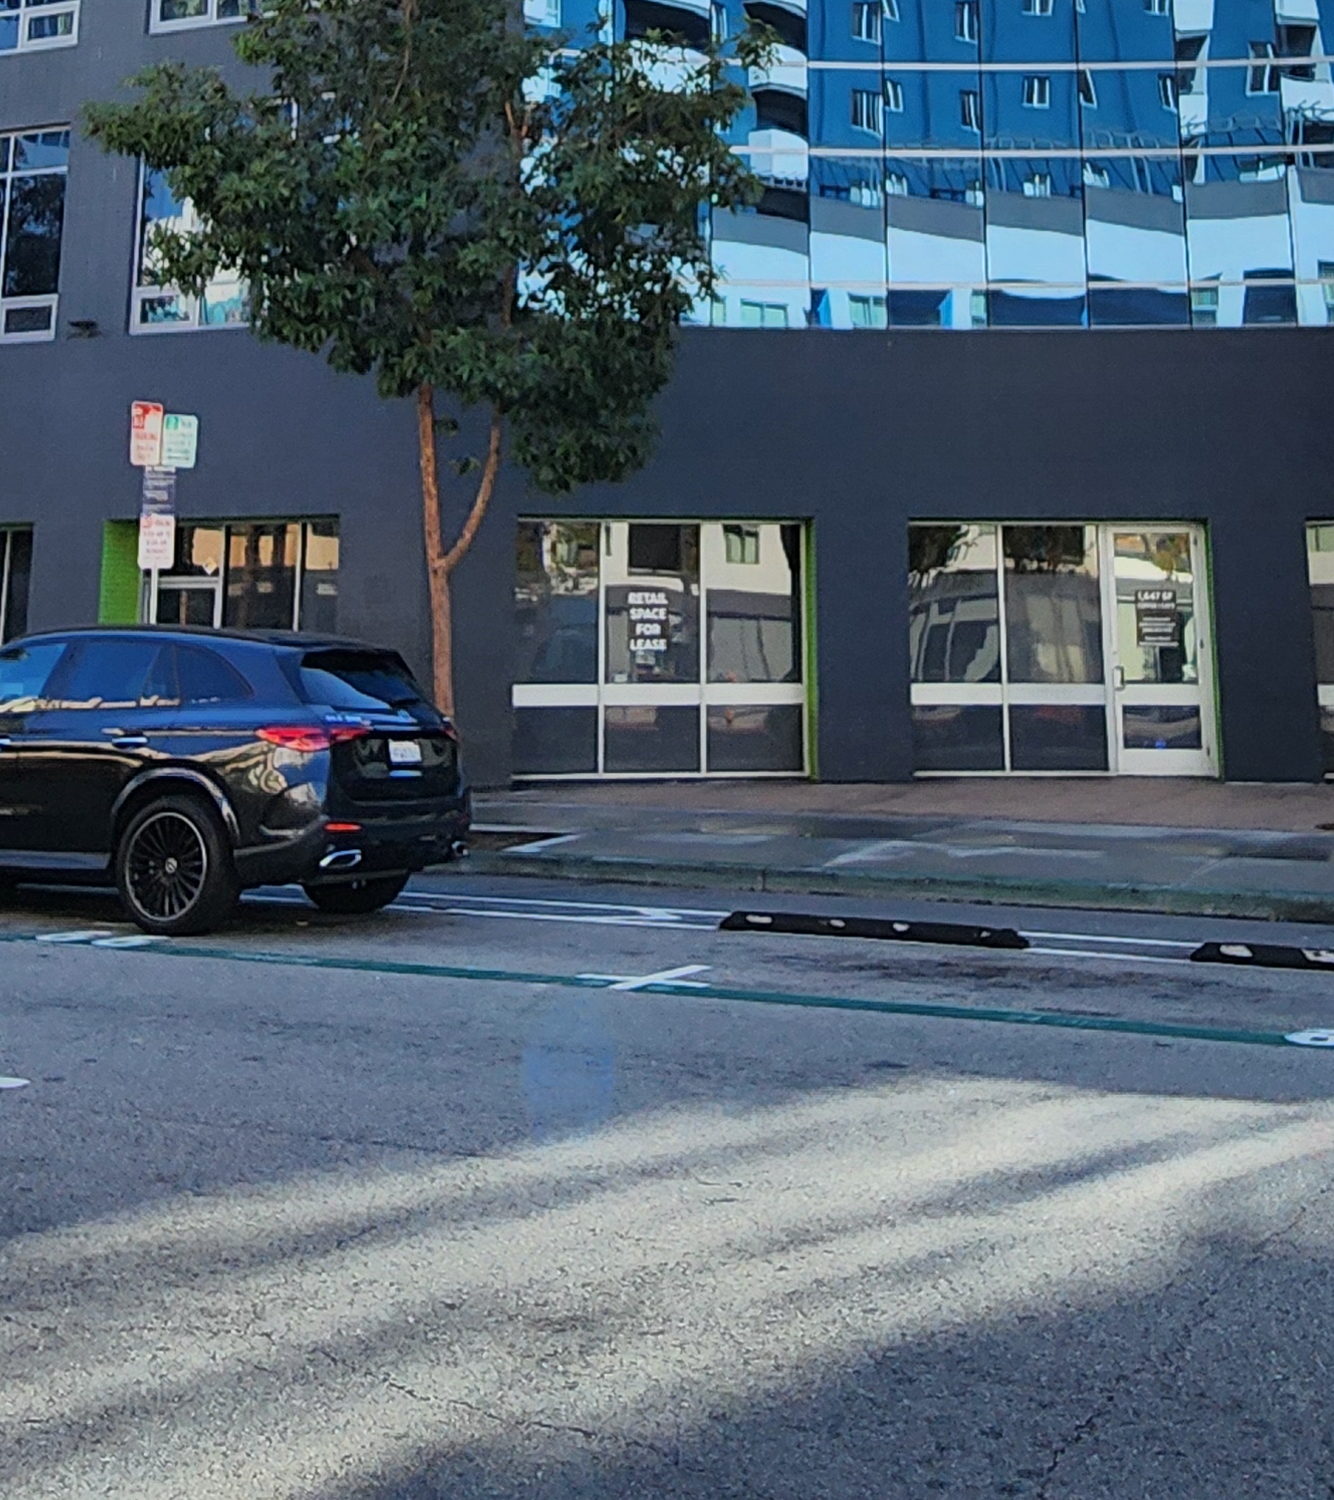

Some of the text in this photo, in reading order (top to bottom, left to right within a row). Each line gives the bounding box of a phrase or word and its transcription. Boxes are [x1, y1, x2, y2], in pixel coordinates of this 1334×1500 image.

[629, 607, 668, 621] SPACE
[635, 623, 662, 636] FOR
[629, 638, 668, 651] LEASE
